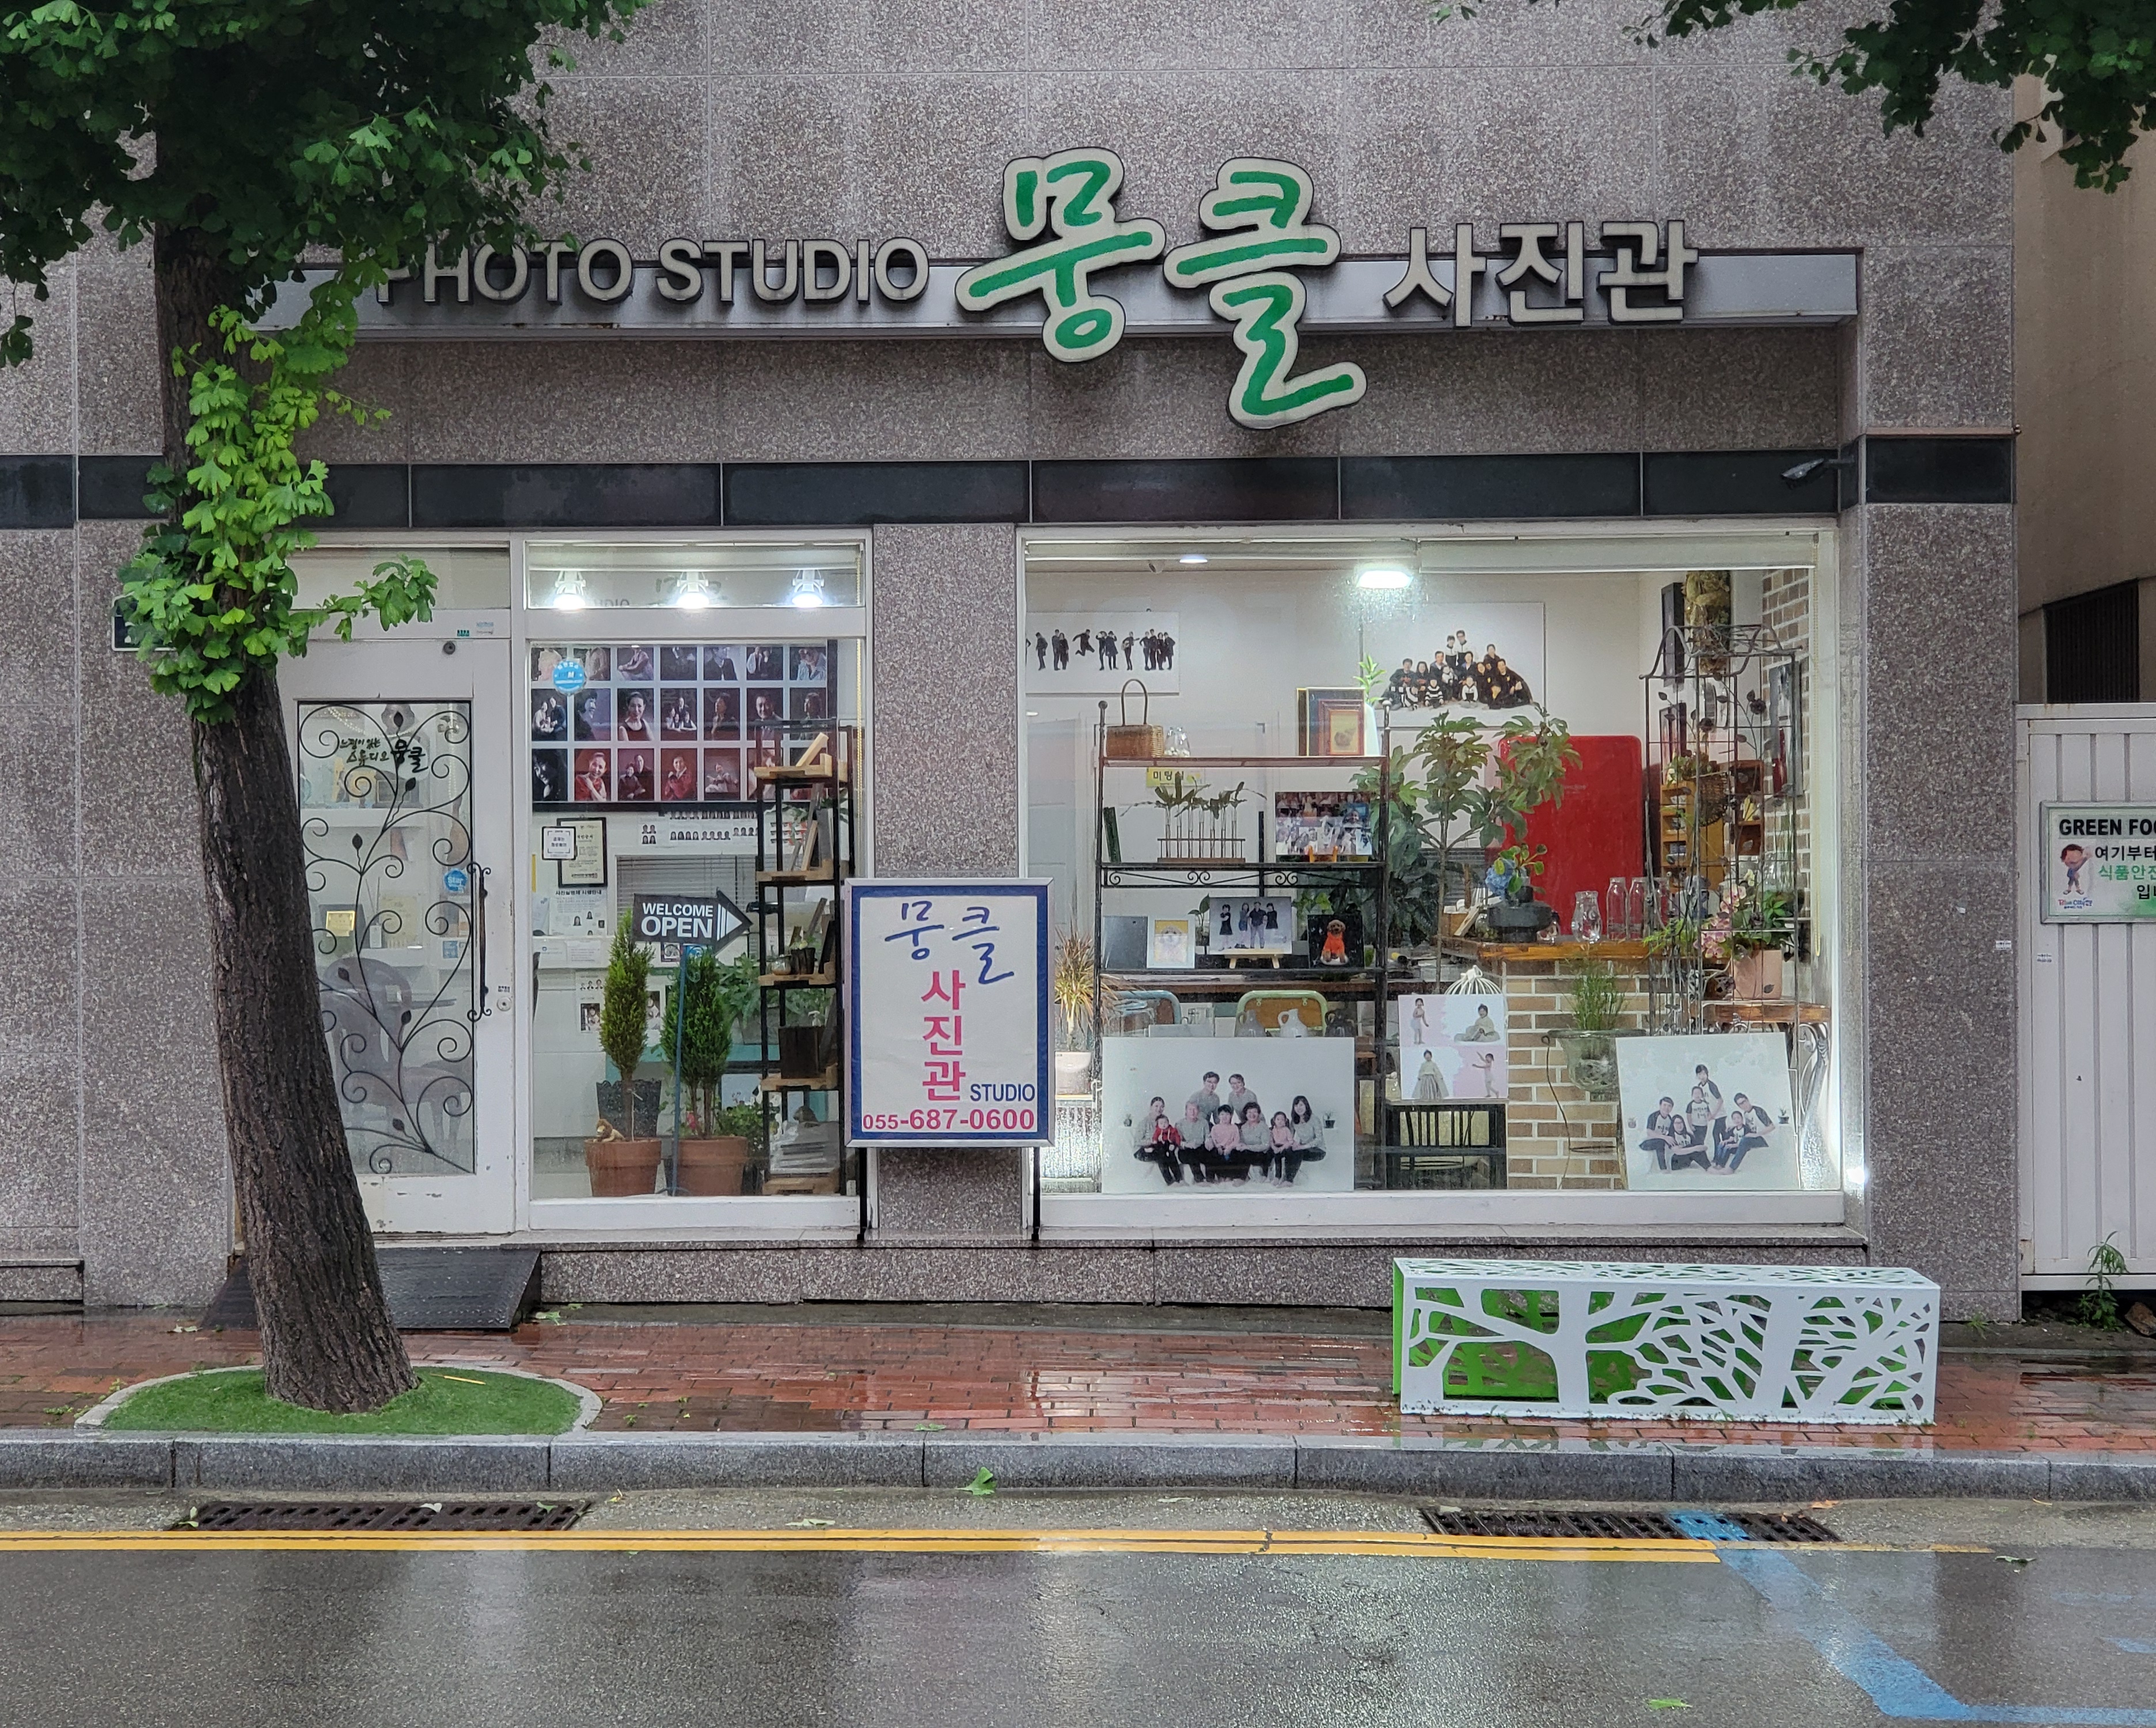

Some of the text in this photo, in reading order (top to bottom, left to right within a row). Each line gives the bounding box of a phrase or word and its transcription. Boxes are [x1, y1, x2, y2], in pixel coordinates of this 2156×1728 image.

[656, 237, 930, 303] STUDIO
[955, 147, 1698, 429] 뭉클 사진관
[2059, 818, 2156, 836] GREEN FO
[2137, 884, 2156, 900] 입
[642, 903, 714, 917] WELCOME
[641, 915, 713, 938] OPEN
[885, 900, 1015, 985] 뭉클
[921, 969, 966, 1101] 사진관
[970, 1083, 1036, 1102] STUDIO
[863, 1109, 1035, 1130] 055-687-0600
